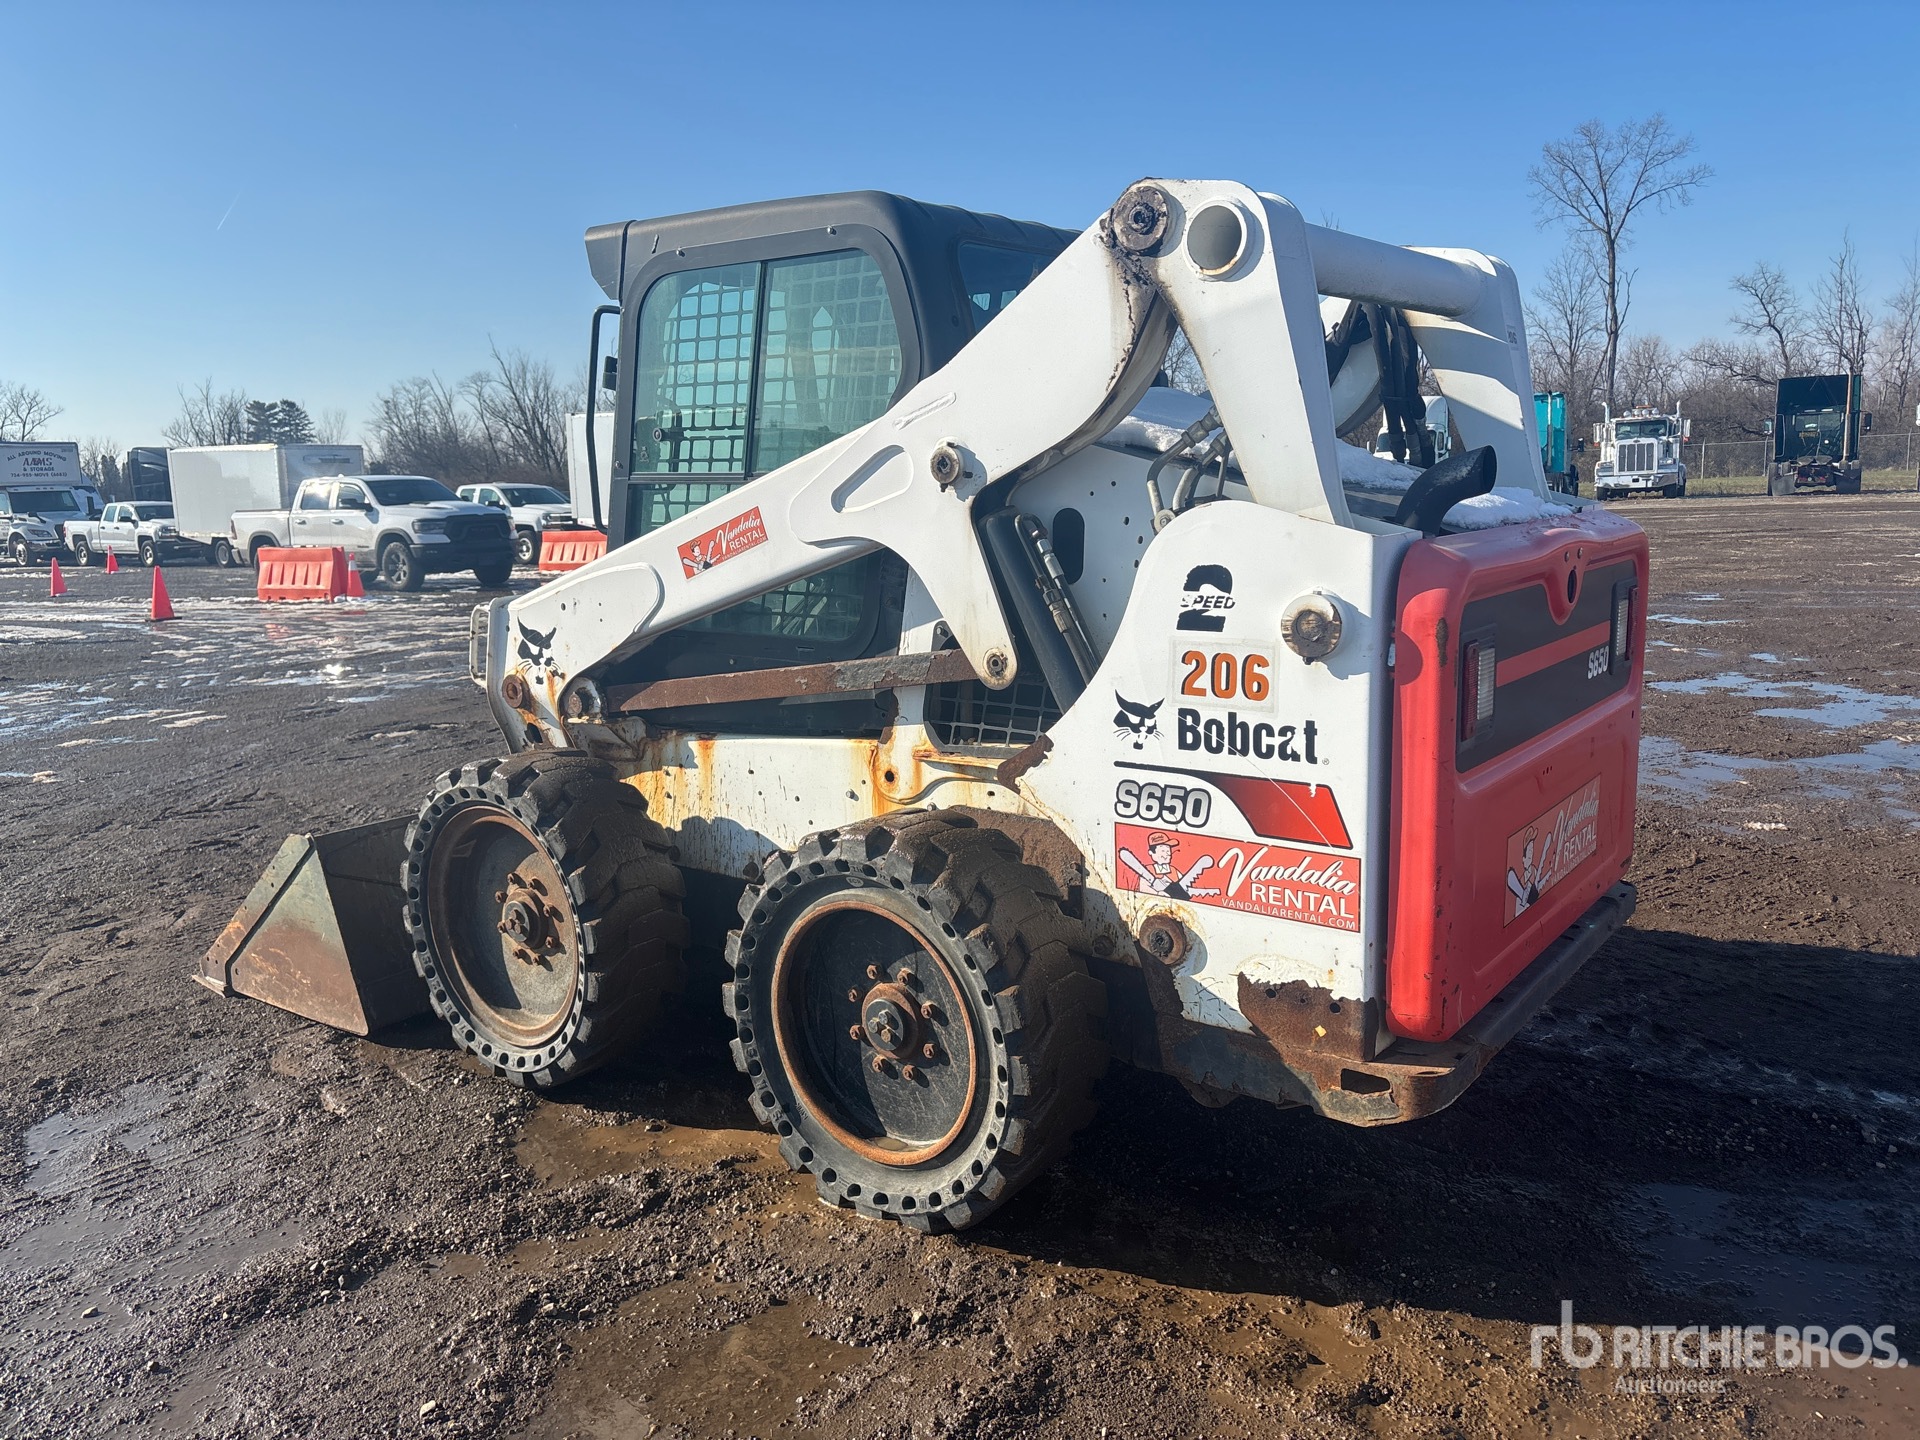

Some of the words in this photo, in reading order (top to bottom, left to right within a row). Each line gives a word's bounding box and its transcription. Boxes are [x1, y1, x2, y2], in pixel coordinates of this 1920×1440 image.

[44, 451, 67, 461] MOVING
[716, 512, 760, 555] Vandalia
[729, 528, 764, 551] RENTAL
[1176, 564, 1233, 632] 2
[1181, 650, 1270, 701] 206
[1588, 645, 1609, 679] S650
[1178, 708, 1318, 764] Bobcat
[1114, 779, 1212, 828] S650
[1553, 781, 1599, 872] Vandalia
[1563, 821, 1597, 864] RENTAL
[1217, 846, 1357, 897] Vandalia
[1221, 898, 1356, 930] VANDALIARENTAL.COM
[1251, 882, 1354, 919] RENTAL
